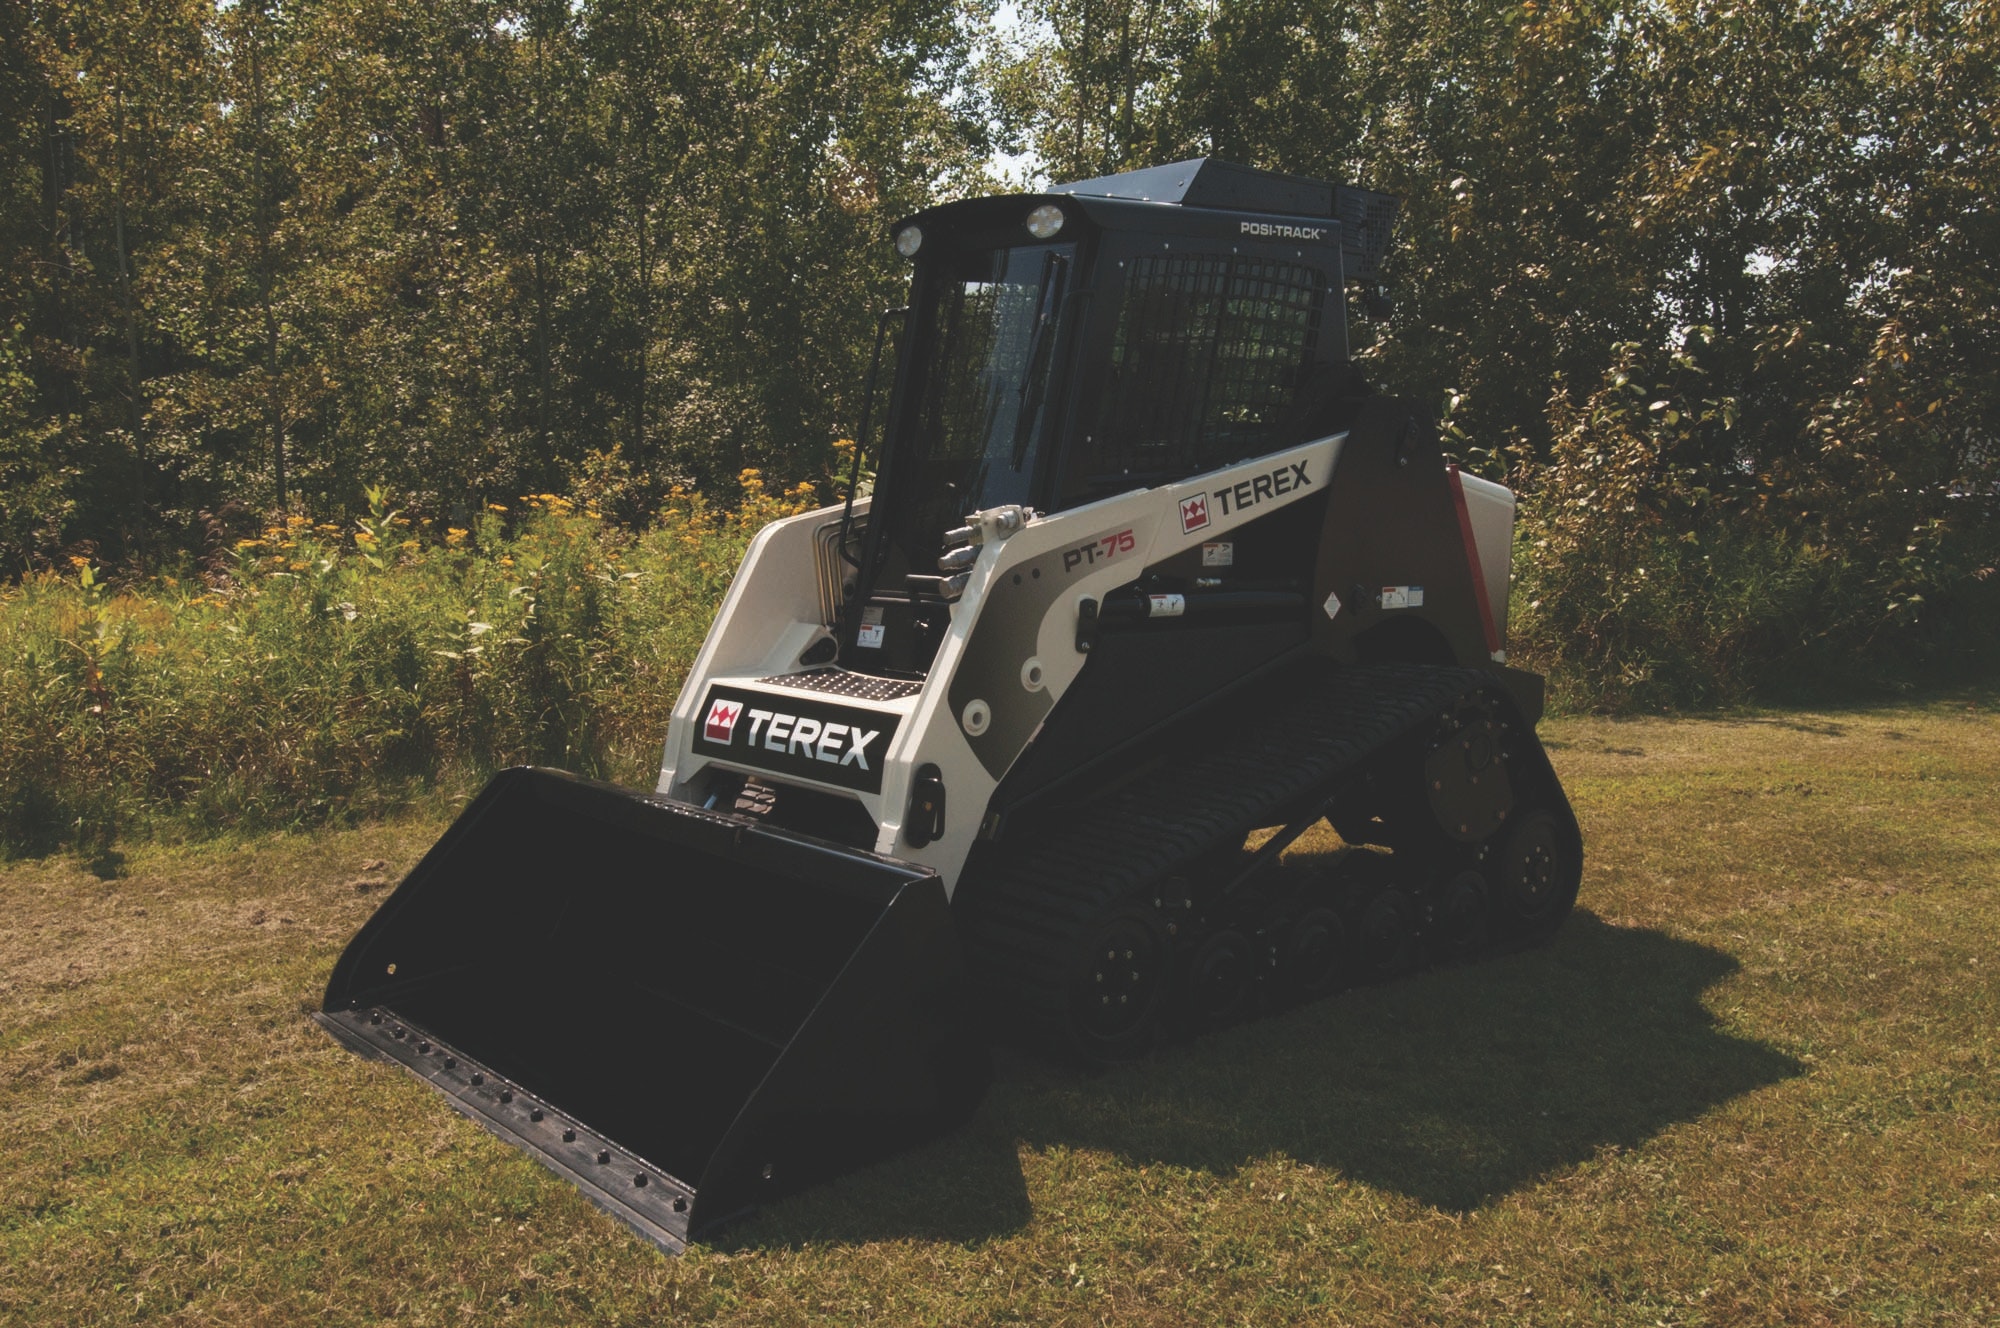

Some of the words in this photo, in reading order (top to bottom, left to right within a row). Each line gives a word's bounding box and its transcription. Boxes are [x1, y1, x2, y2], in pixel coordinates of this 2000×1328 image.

[1241, 222, 1320, 239] POSI-TRACK
[1214, 459, 1311, 515] TEREX
[1063, 529, 1135, 572] PT-75
[748, 708, 880, 771] TEREX
